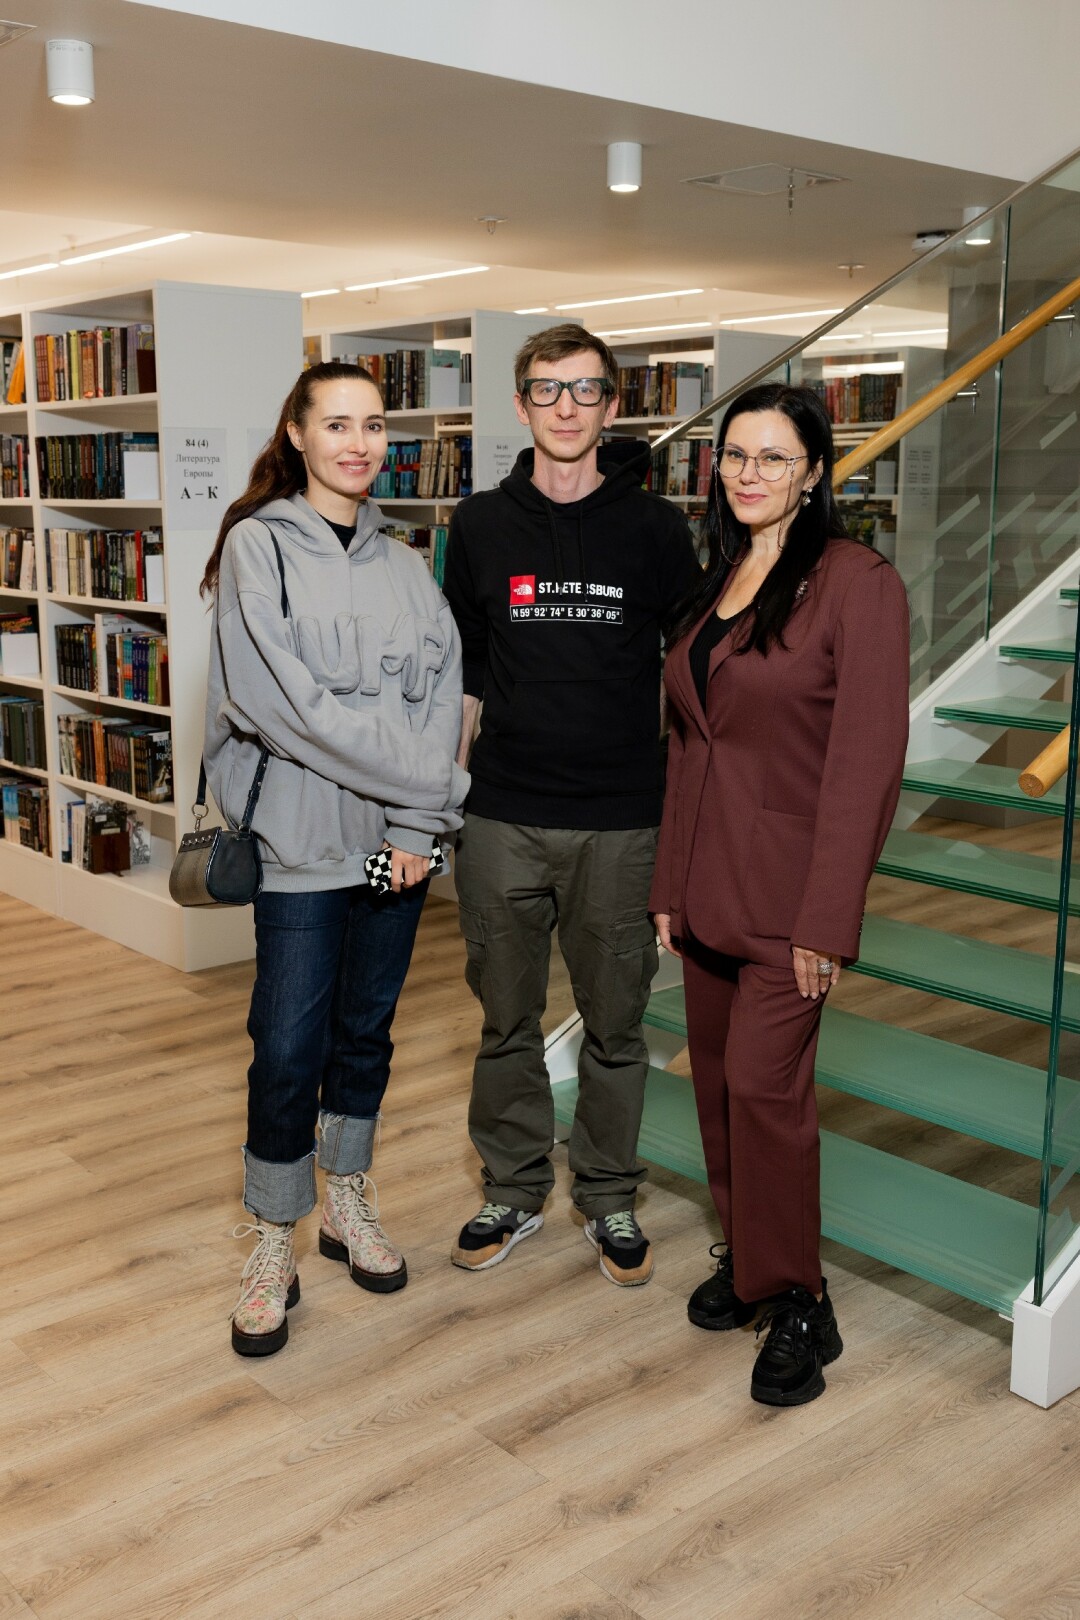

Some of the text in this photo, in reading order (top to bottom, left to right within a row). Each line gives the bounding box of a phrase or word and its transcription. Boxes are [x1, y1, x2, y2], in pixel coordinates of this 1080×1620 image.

[185, 439, 209, 448] 84 (4)
[175, 454, 220, 465] Литература
[183, 469, 213, 479] Европы
[181, 486, 191, 499] А
[208, 486, 218, 499] К
